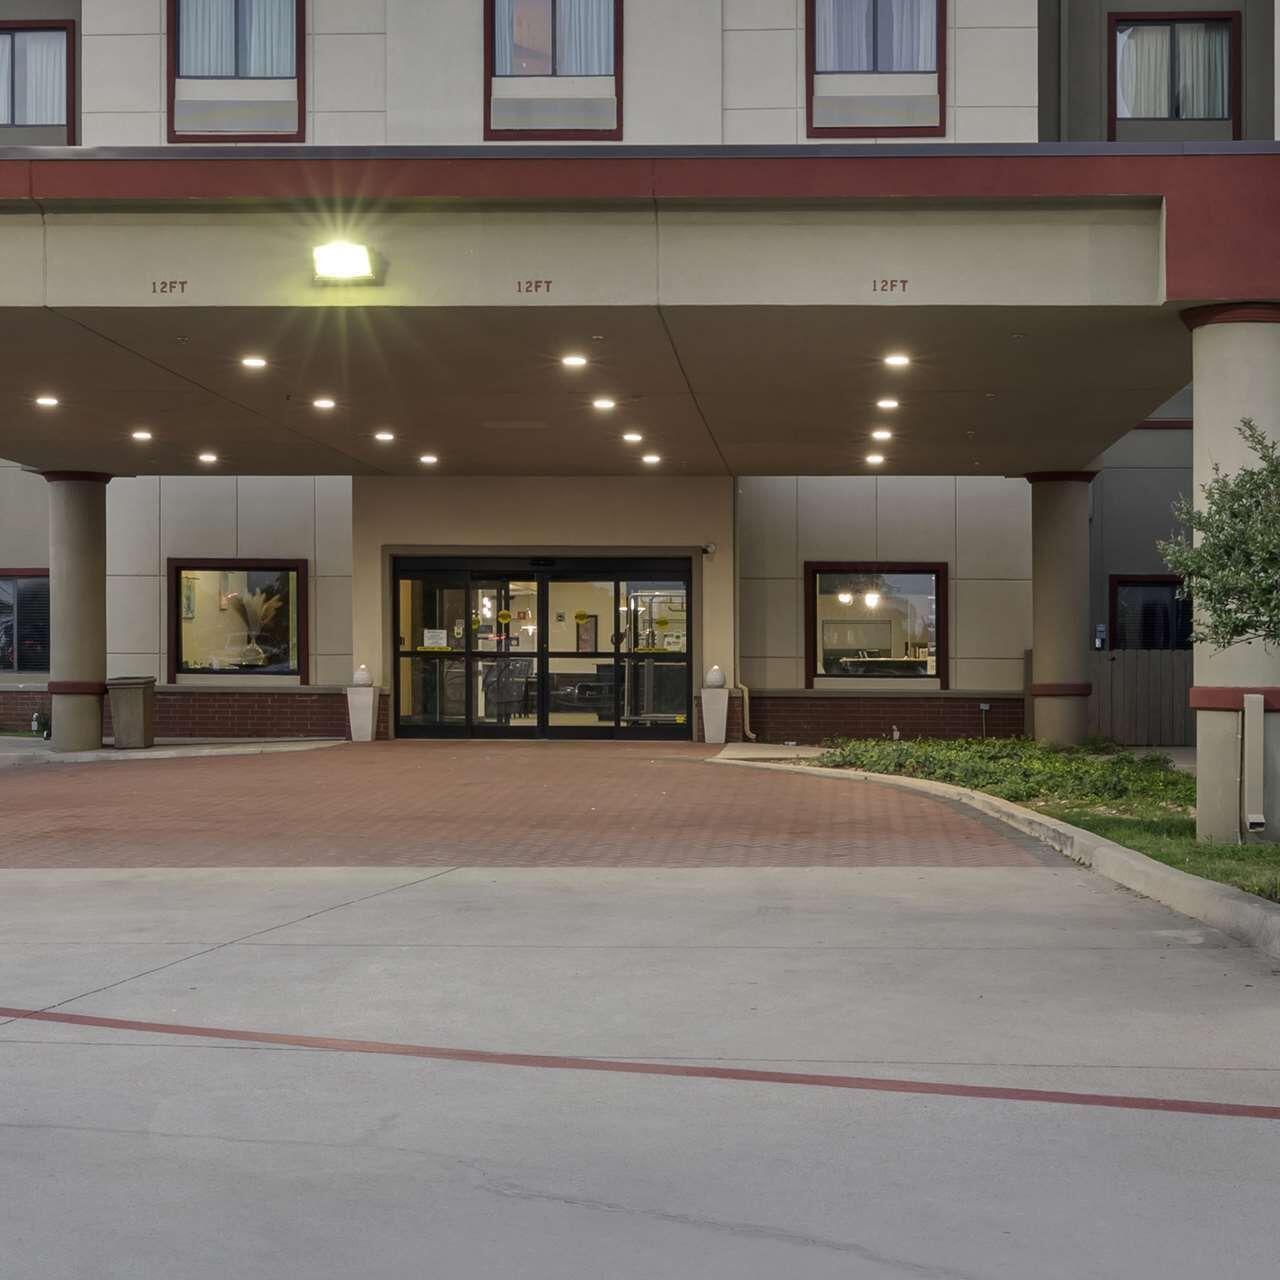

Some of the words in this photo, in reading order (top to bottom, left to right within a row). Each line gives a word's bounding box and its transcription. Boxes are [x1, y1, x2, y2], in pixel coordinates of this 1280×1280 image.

[152, 281, 188, 293] 12FT
[517, 280, 553, 292] 12FT
[872, 280, 909, 292] 12FT
